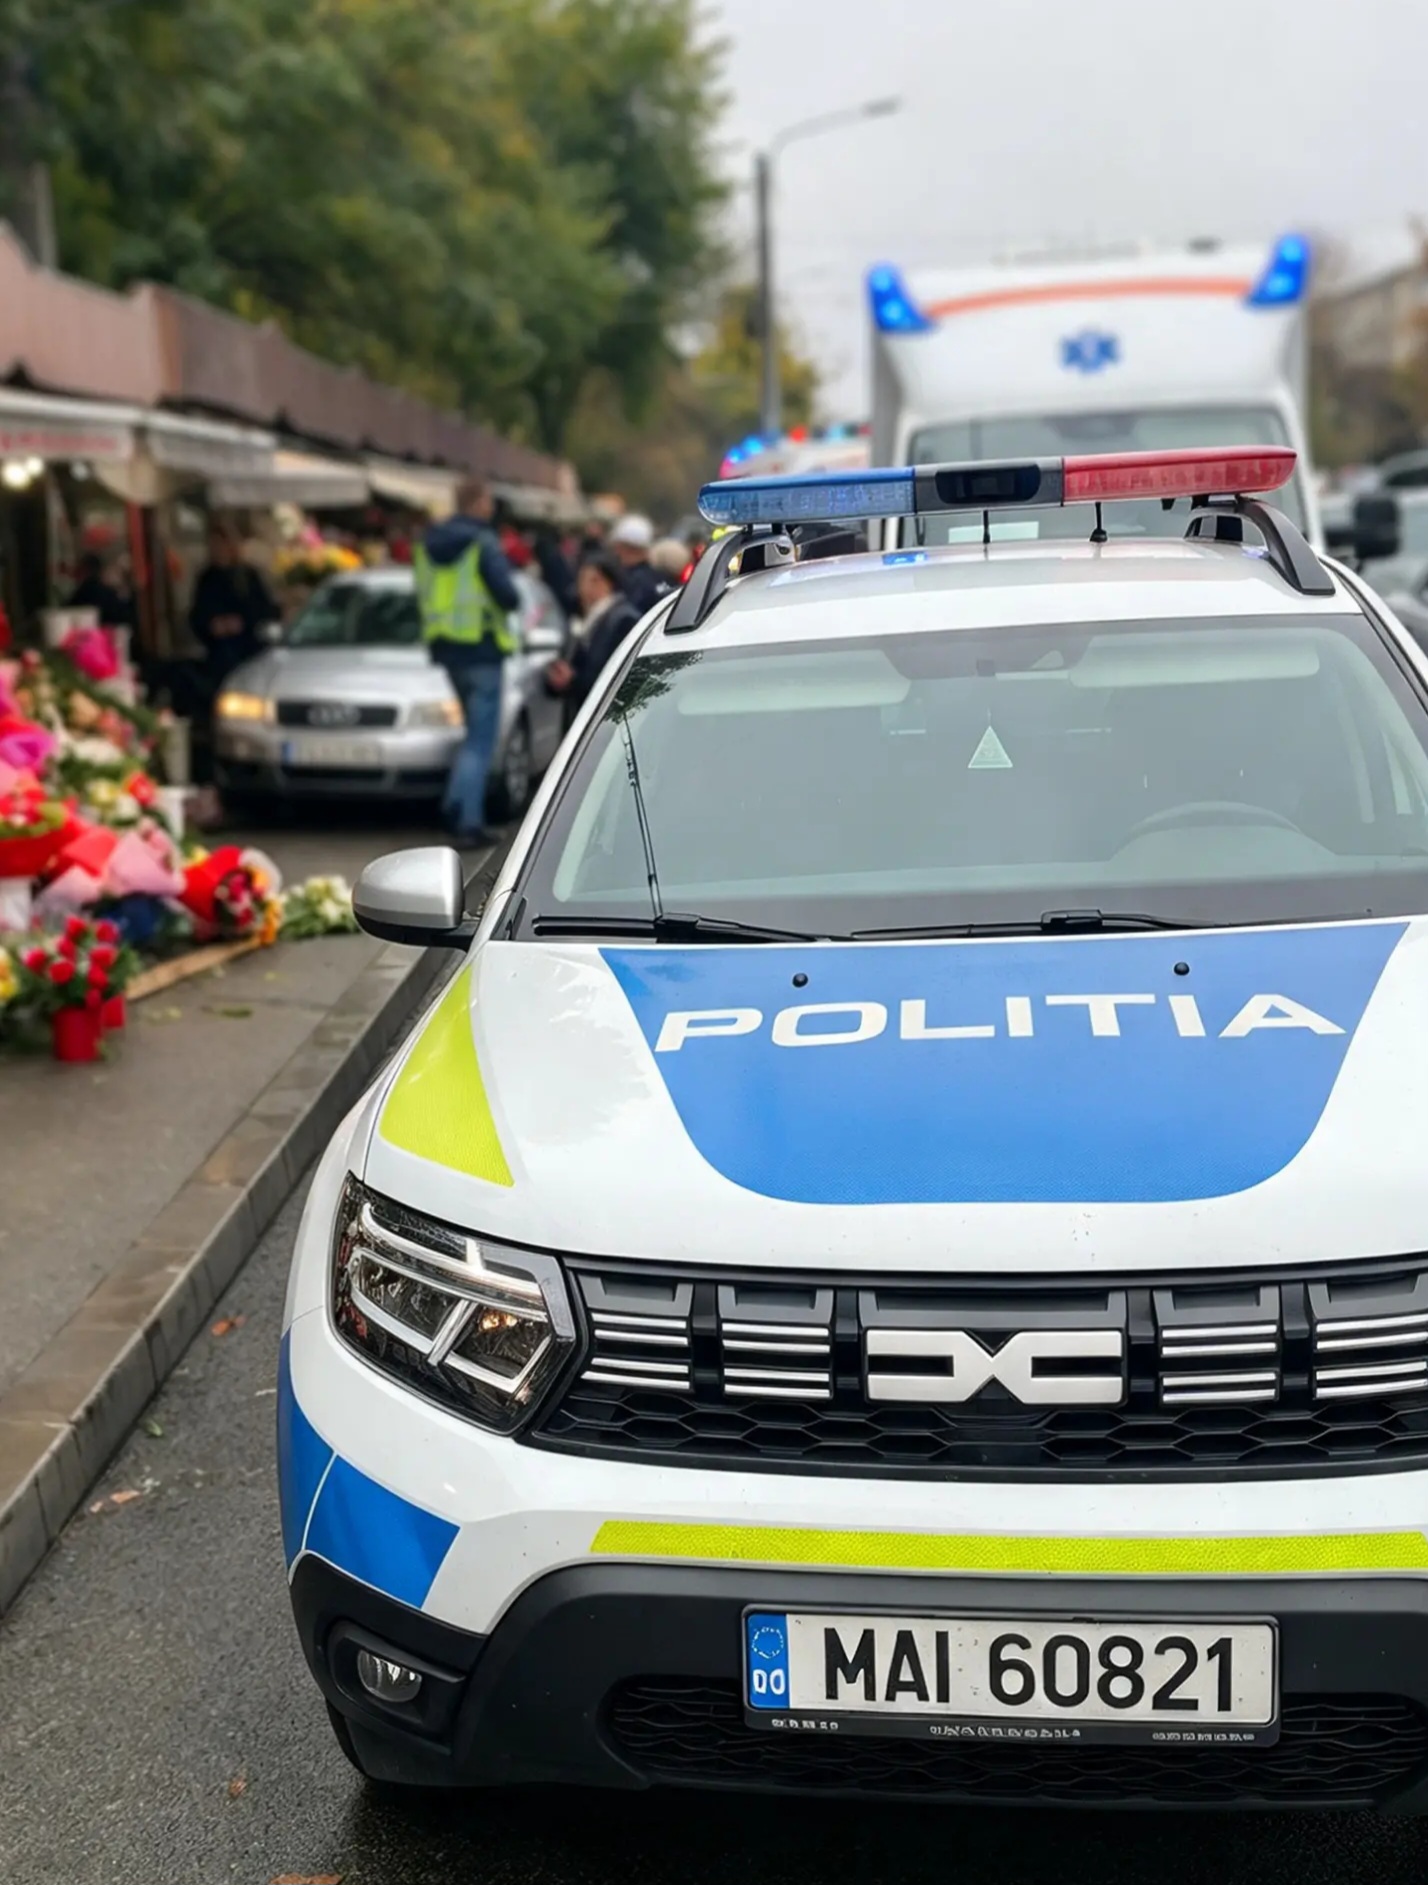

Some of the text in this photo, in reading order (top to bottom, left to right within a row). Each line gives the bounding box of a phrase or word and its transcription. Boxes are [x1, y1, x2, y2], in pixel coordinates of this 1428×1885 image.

[654, 992, 1348, 1053] POLITIA
[824, 1627, 1233, 1712] MAI 60821
